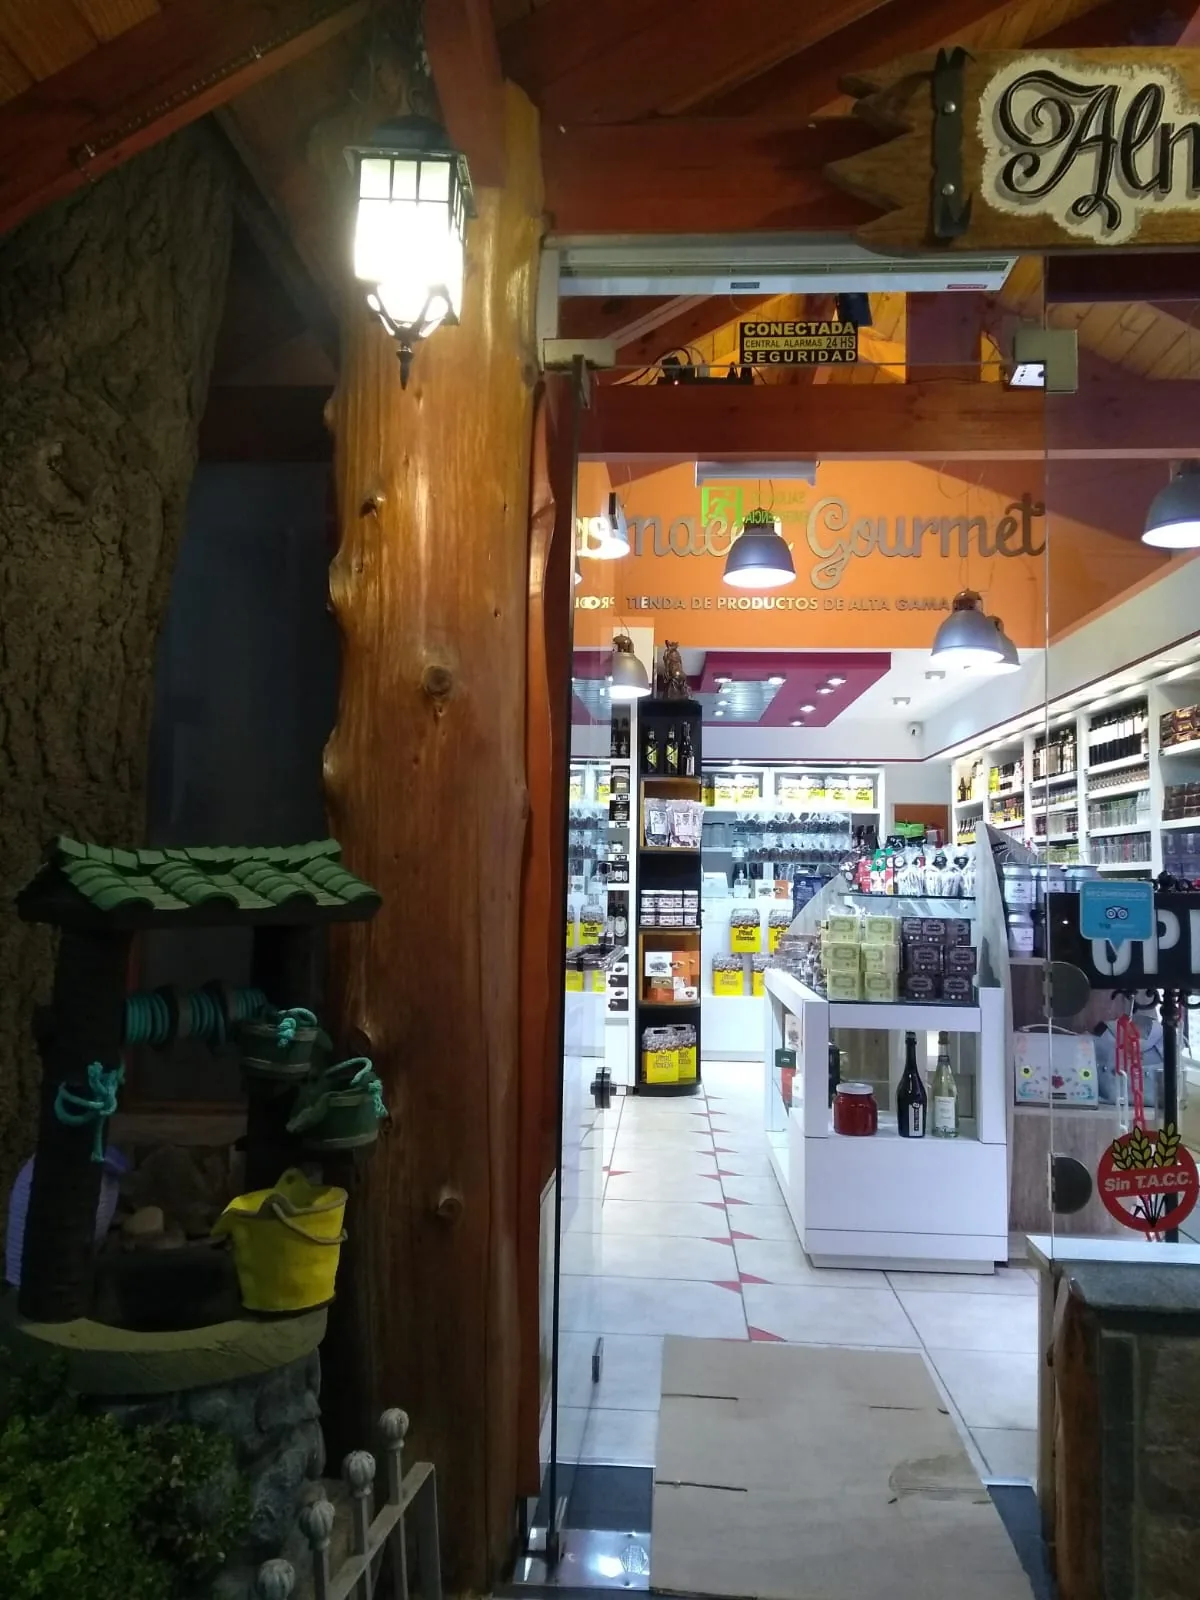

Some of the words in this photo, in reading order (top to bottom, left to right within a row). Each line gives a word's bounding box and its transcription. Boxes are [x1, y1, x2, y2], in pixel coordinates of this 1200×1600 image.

[743, 322, 856, 336] CONECTADA
[745, 340, 780, 348] CENTRAL
[783, 339, 822, 347] ALARMAS
[826, 337, 838, 349] 24
[840, 337, 854, 348] HS
[743, 350, 856, 362] SEGURIDAD
[806, 493, 1045, 590] Gourmet
[626, 597, 687, 610] TIENDA
[691, 597, 712, 610] DE
[717, 597, 818, 611] PRODUCTOS
[824, 598, 845, 611] DE
[849, 598, 890, 611] ALTA
[895, 598, 951, 611] GAMA
[1105, 1177, 1130, 1192] Sin
[1135, 1171, 1193, 1189] T.A.C.C.
